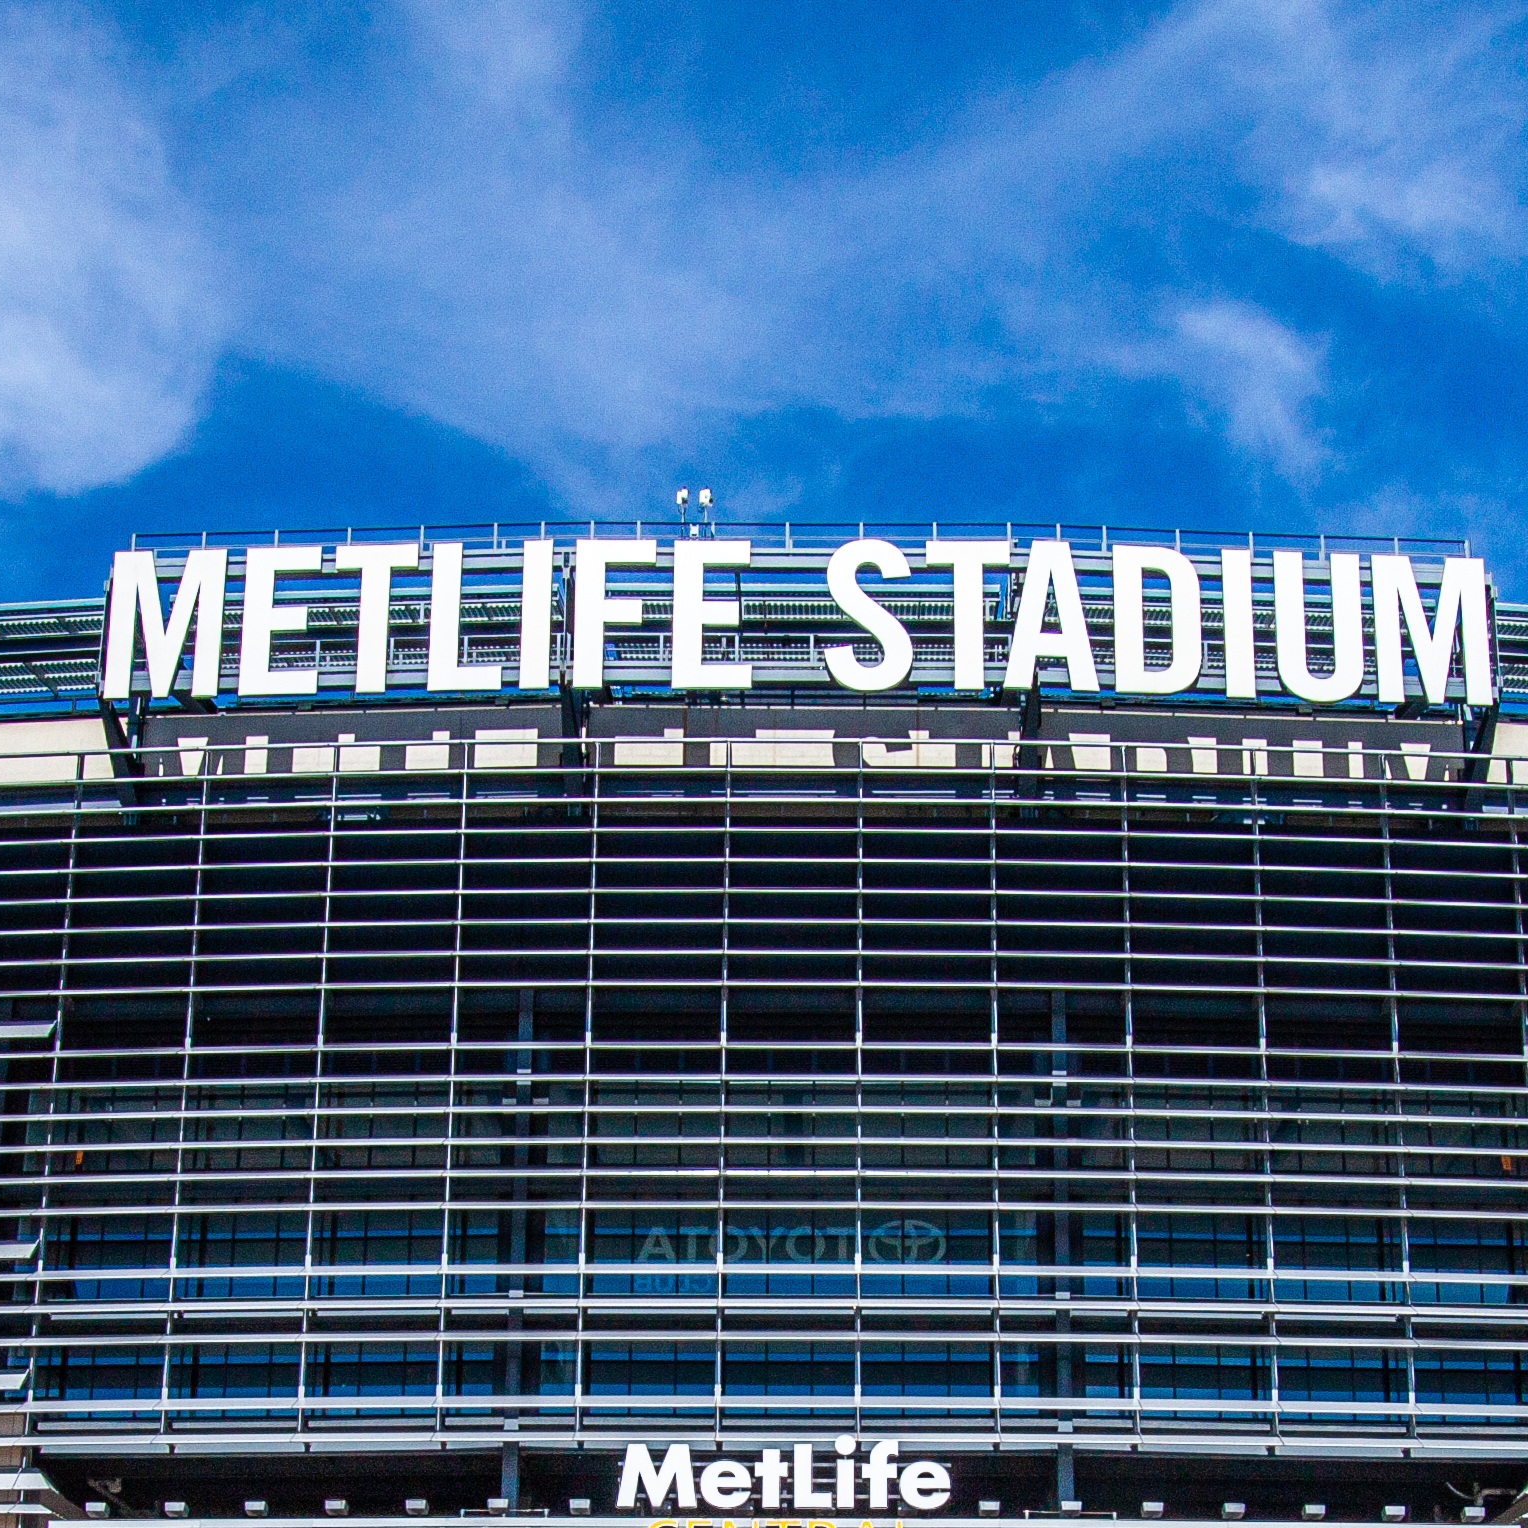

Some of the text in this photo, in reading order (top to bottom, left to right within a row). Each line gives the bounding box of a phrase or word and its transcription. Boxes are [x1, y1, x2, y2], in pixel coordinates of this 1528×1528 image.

[103, 538, 1494, 706] METLIFE STADIUM
[615, 1434, 951, 1509] MetLife
